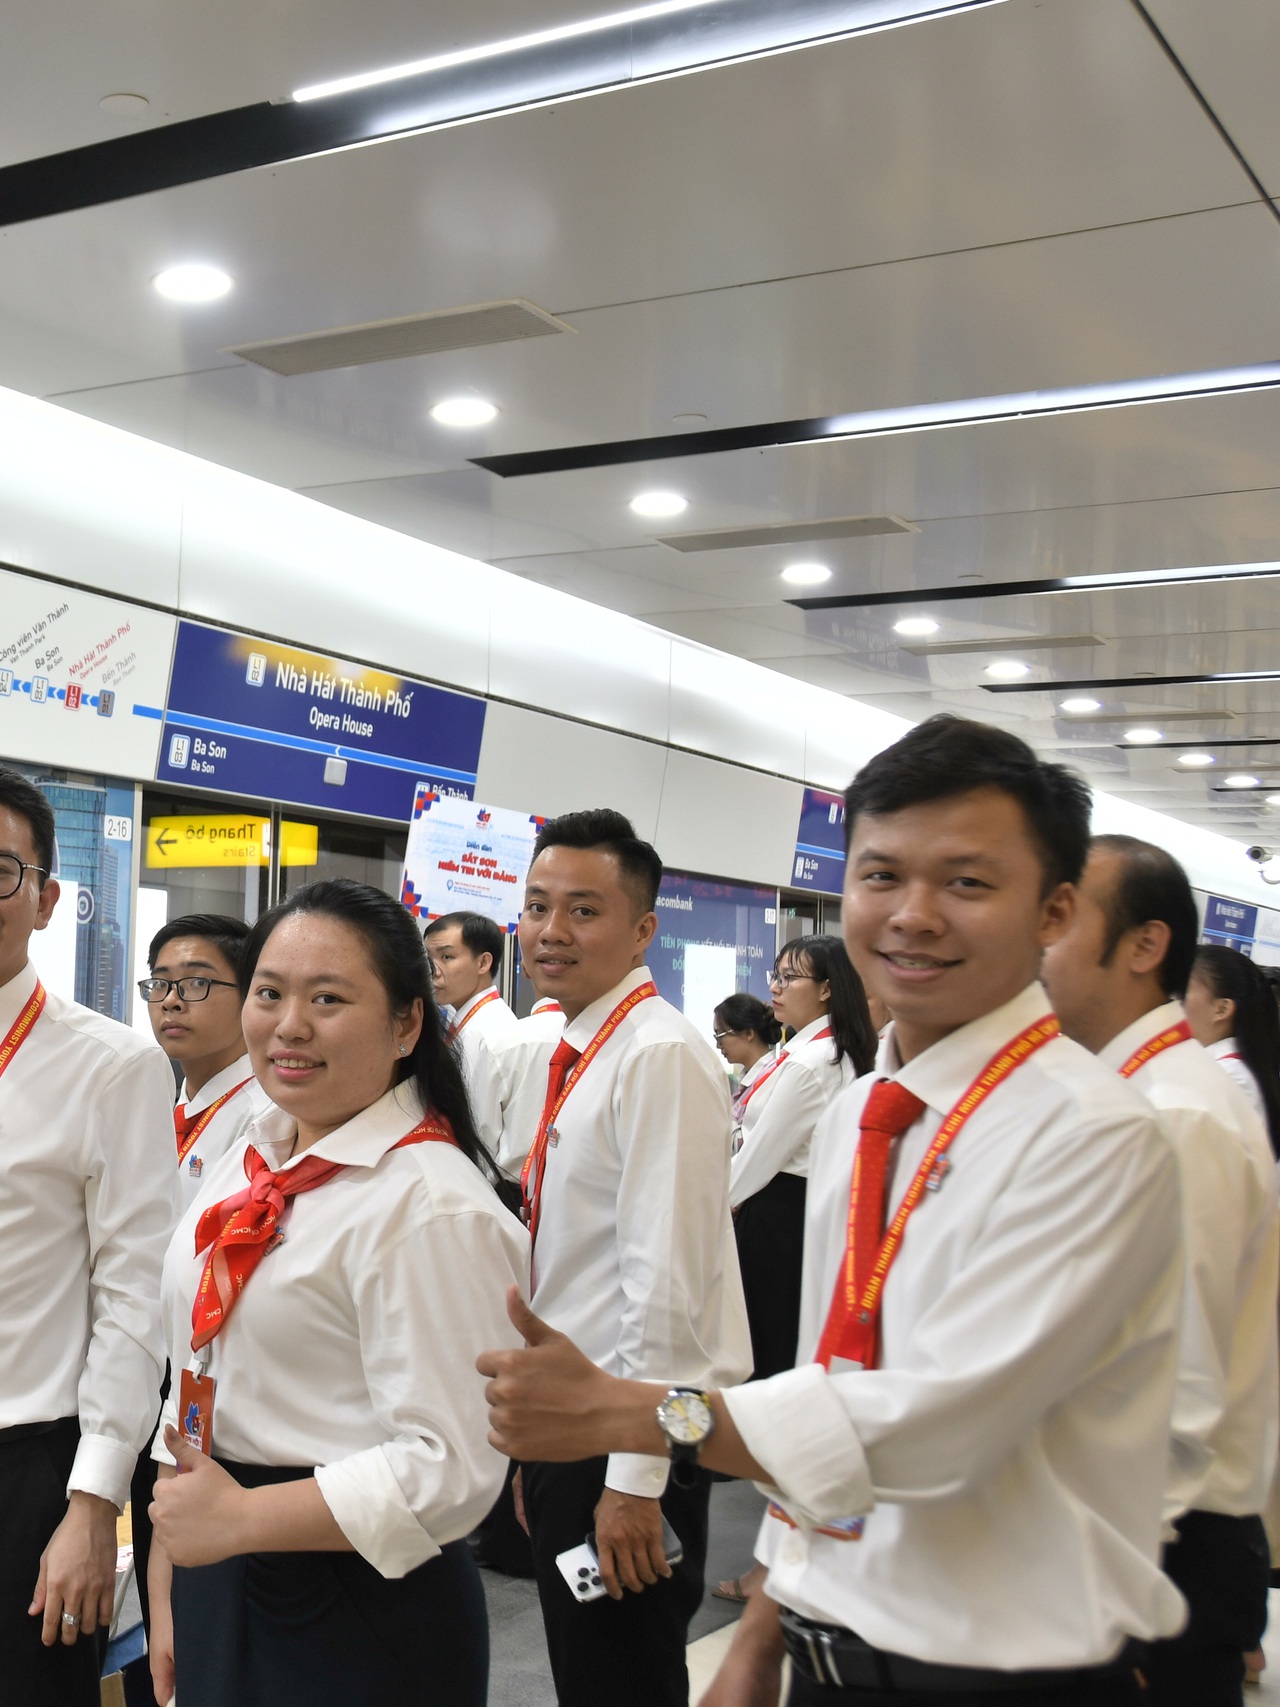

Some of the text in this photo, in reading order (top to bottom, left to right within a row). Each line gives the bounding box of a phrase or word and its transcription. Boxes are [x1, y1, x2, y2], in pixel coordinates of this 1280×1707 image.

[253, 657, 262, 670] L1
[251, 670, 260, 682] 02
[275, 661, 414, 718] Nhà Hát Thành Phố
[309, 706, 374, 738] Opera House
[177, 738, 186, 752] L1
[194, 738, 227, 760] Ba Son
[174, 752, 184, 764] 03
[191, 759, 215, 774] Ba Son
[107, 818, 128, 838] 2-16
[656, 894, 694, 911] acombank
